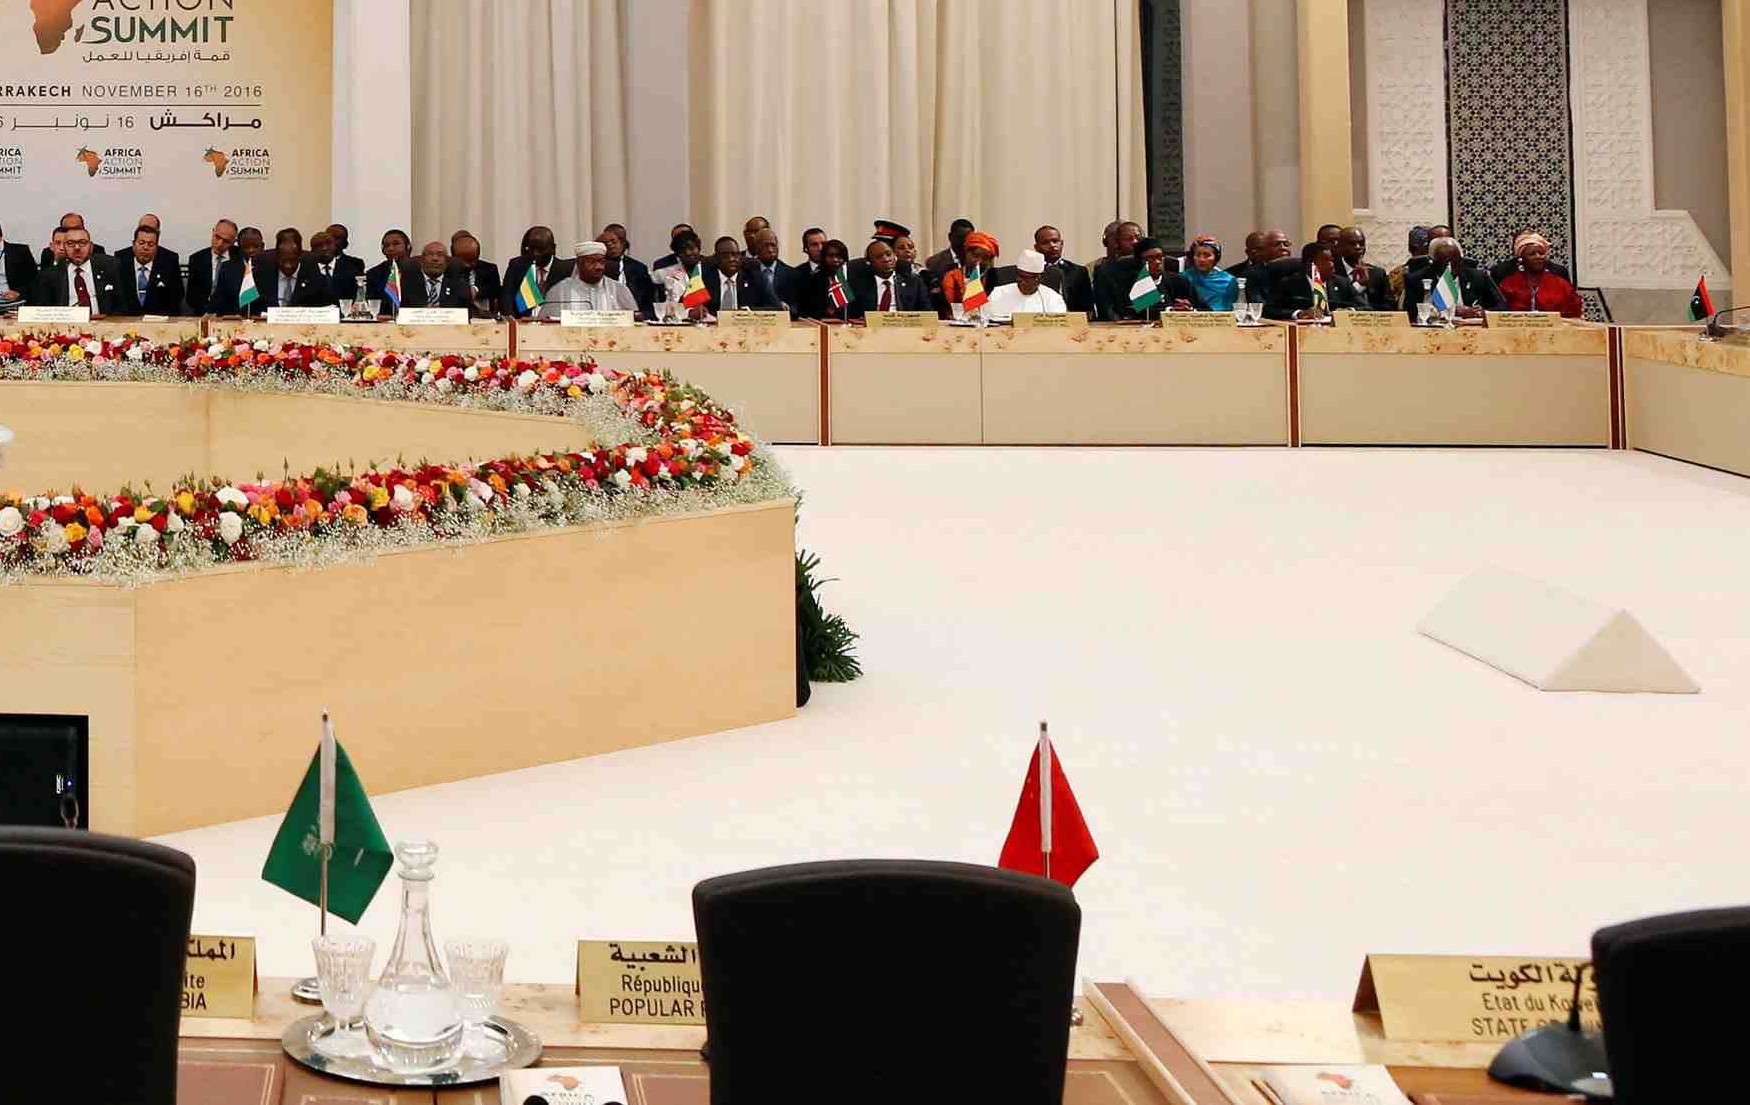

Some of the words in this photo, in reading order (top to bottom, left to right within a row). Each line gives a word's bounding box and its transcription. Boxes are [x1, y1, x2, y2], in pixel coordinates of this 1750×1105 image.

[84, 16, 234, 44] SUMMIT
[82, 51, 133, 63] للعمل
[136, 49, 191, 64] إفريقيا
[193, 49, 230, 62] قمة
[82, 85, 178, 97] NOVEMBER
[224, 85, 262, 97] 2016
[11, 113, 110, 132] نونبر
[117, 115, 134, 129] 16
[149, 108, 262, 131] مراكش
[104, 148, 142, 157] AFRICA
[231, 148, 270, 157] AFRICA
[103, 157, 143, 166] ACTION
[231, 158, 270, 166] ACTION
[102, 166, 142, 175] SUMMIT
[230, 166, 270, 175] SUMMIT
[609, 943, 696, 972] الشعبية
[1469, 963, 1554, 990] الكويت
[621, 974, 700, 998] Républiqu
[609, 998, 695, 1017] POPULAR
[1482, 992, 1521, 1012] Etat
[1524, 993, 1545, 1012] du
